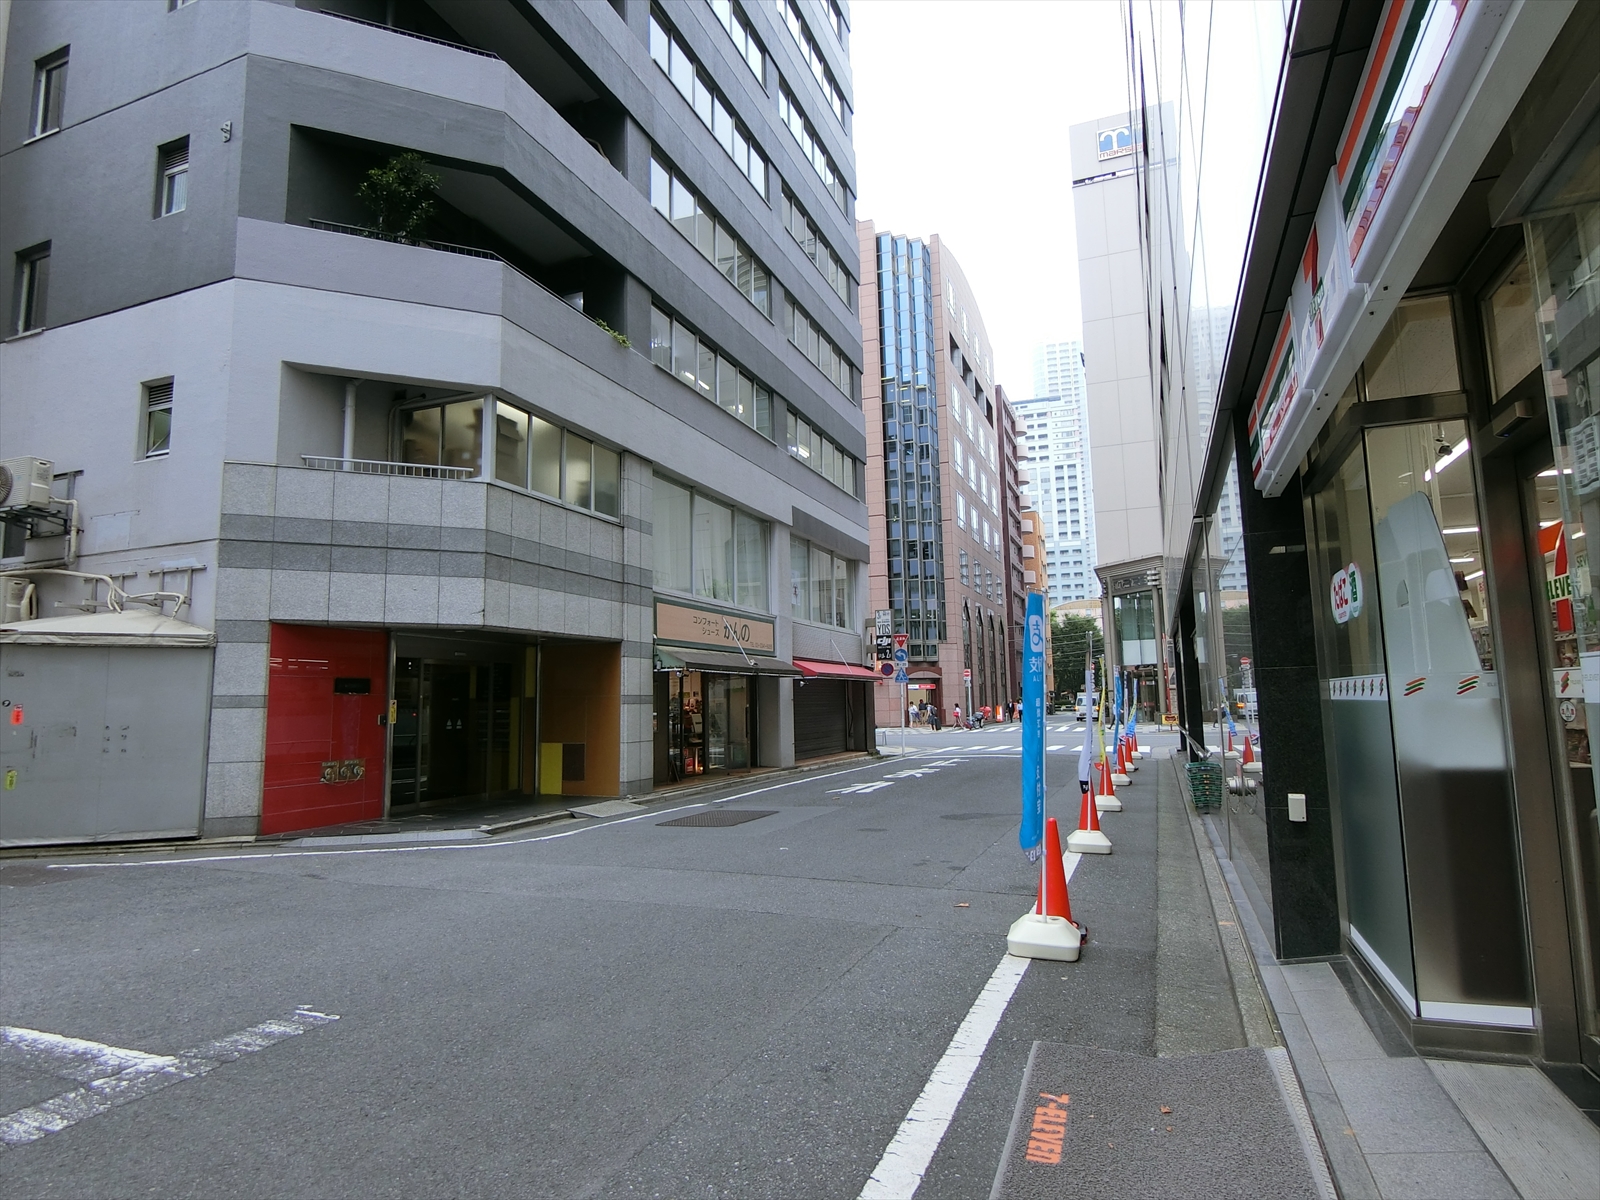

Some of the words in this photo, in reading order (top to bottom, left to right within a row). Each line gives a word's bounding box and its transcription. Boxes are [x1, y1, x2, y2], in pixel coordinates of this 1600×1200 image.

[692, 615, 719, 626] コンフォート
[702, 627, 720, 637] シューズ
[723, 621, 751, 643] かんの
[877, 623, 891, 635] YDS
